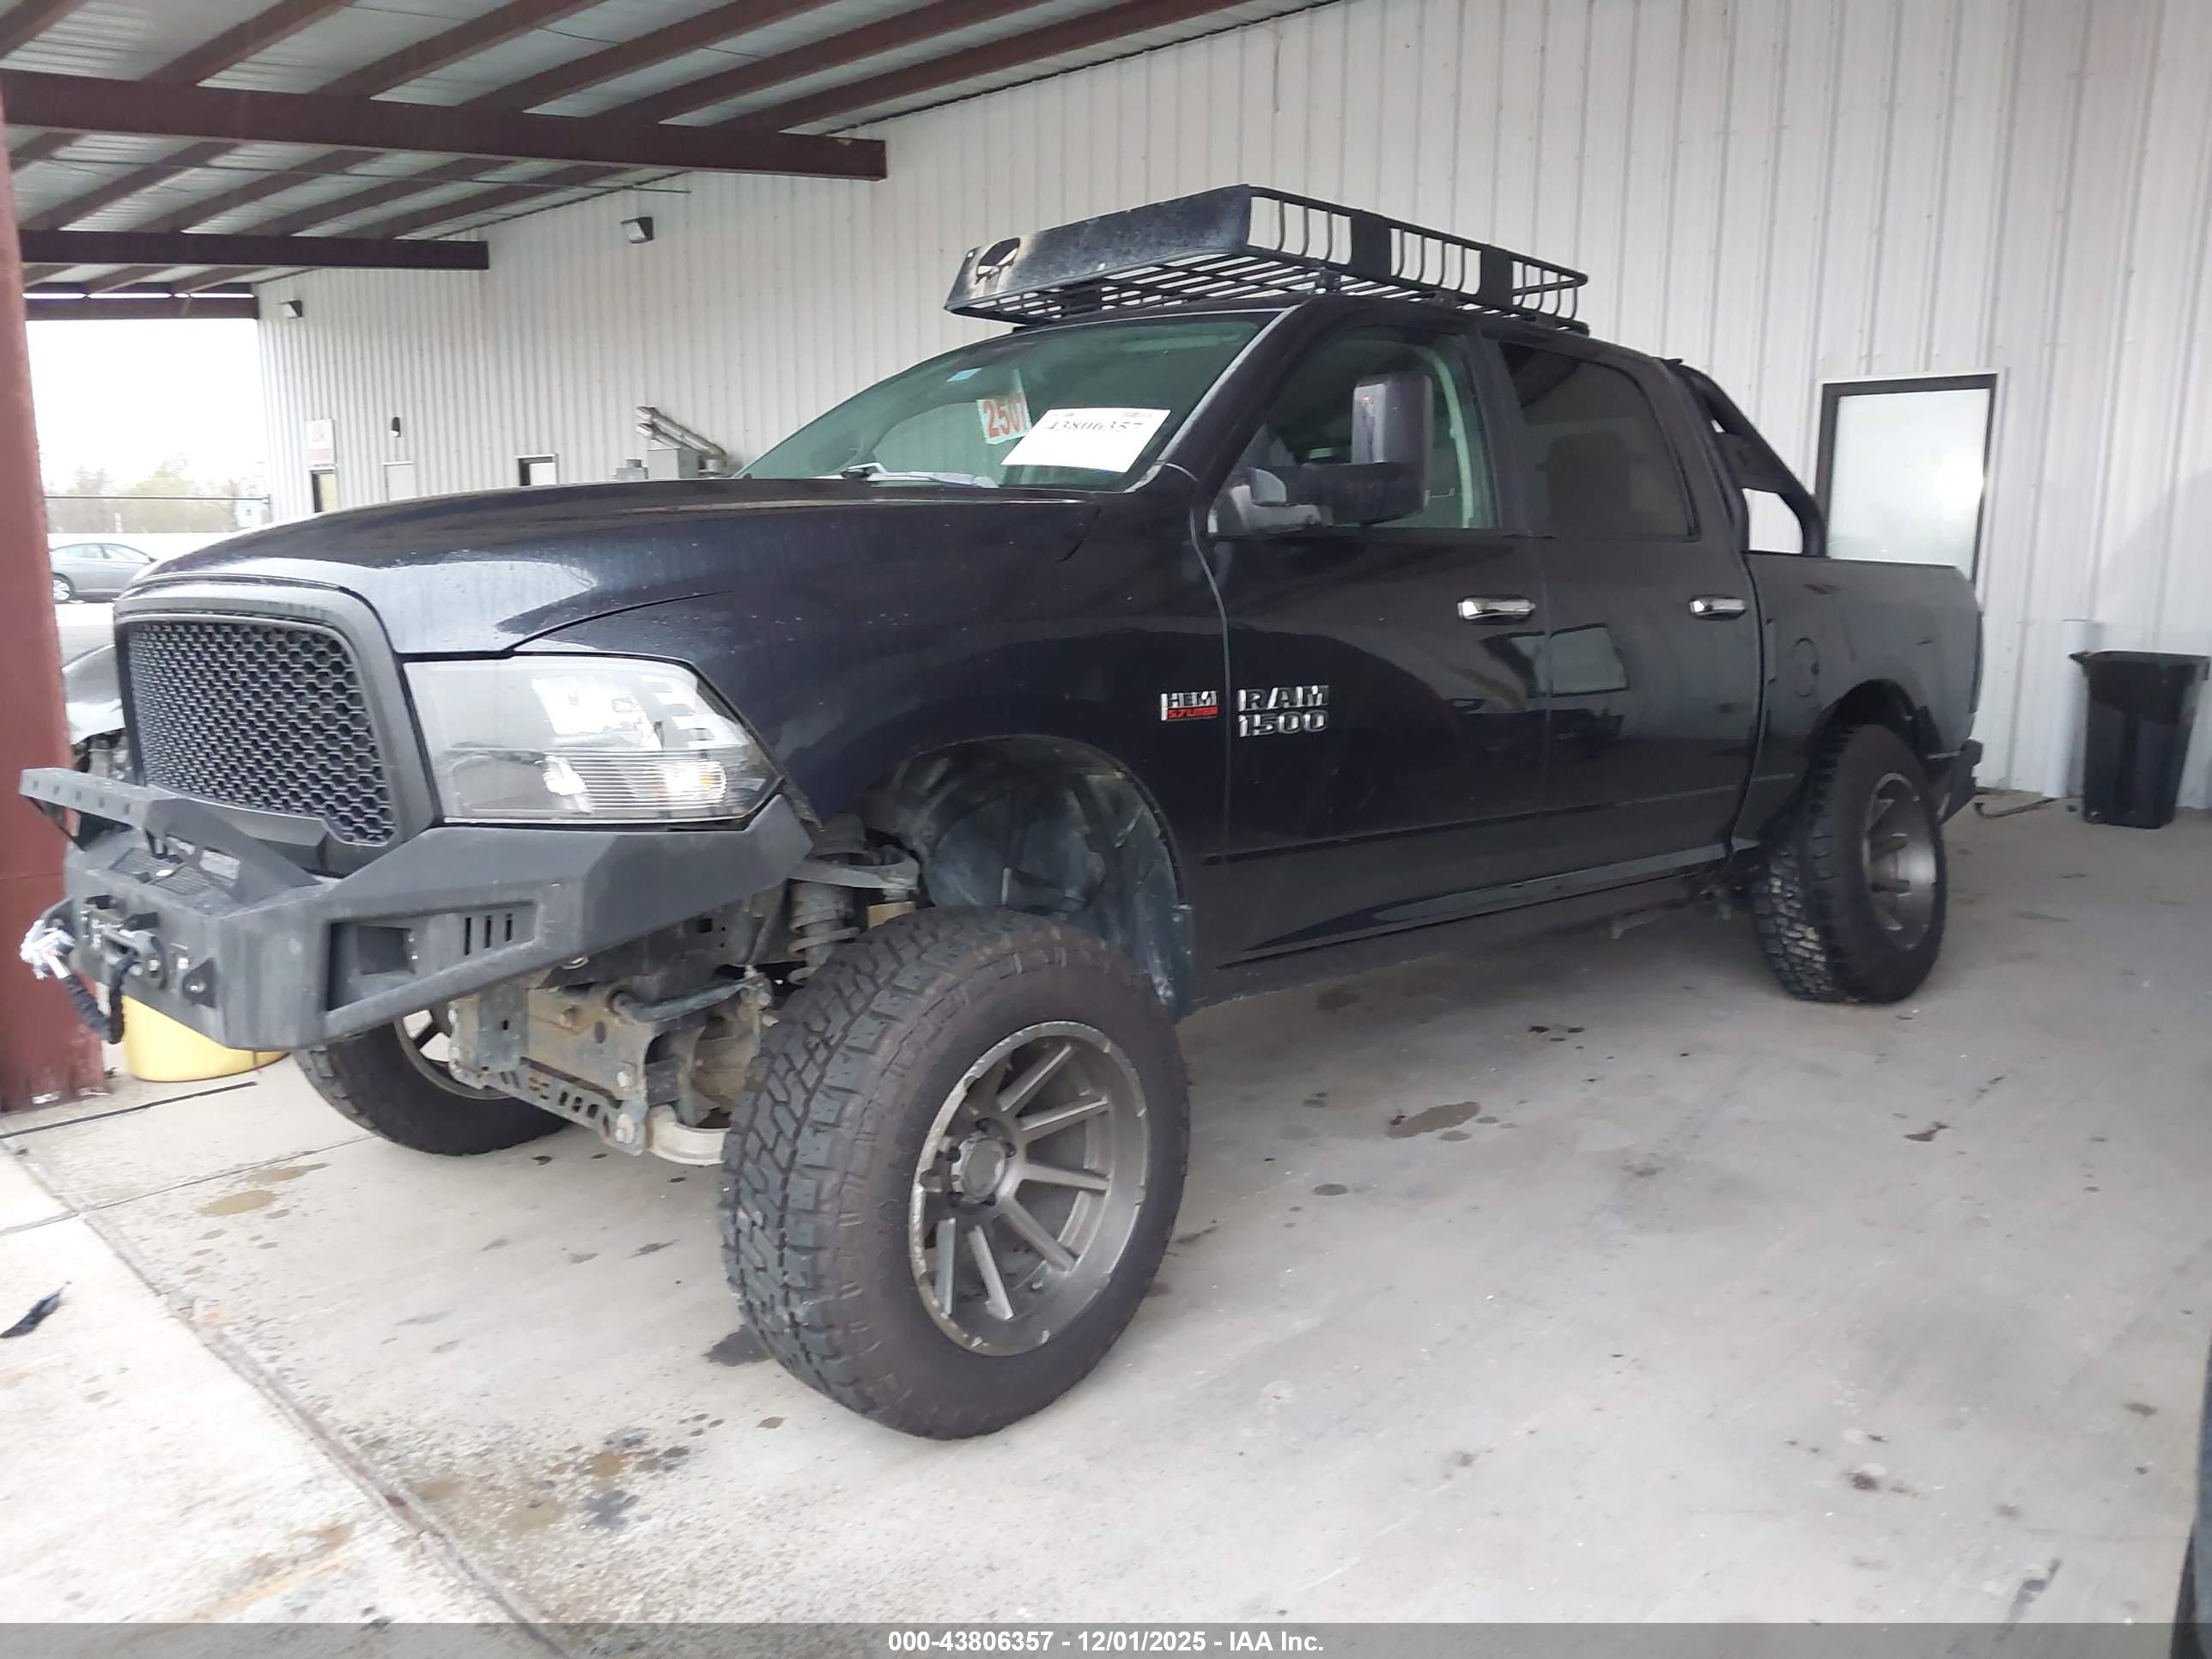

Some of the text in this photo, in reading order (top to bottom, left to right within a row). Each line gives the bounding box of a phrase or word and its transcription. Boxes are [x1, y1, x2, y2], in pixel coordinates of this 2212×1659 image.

[1044, 420, 1145, 434] 43806357
[1237, 684, 1329, 712] RAM
[1237, 709, 1328, 738] 1500
